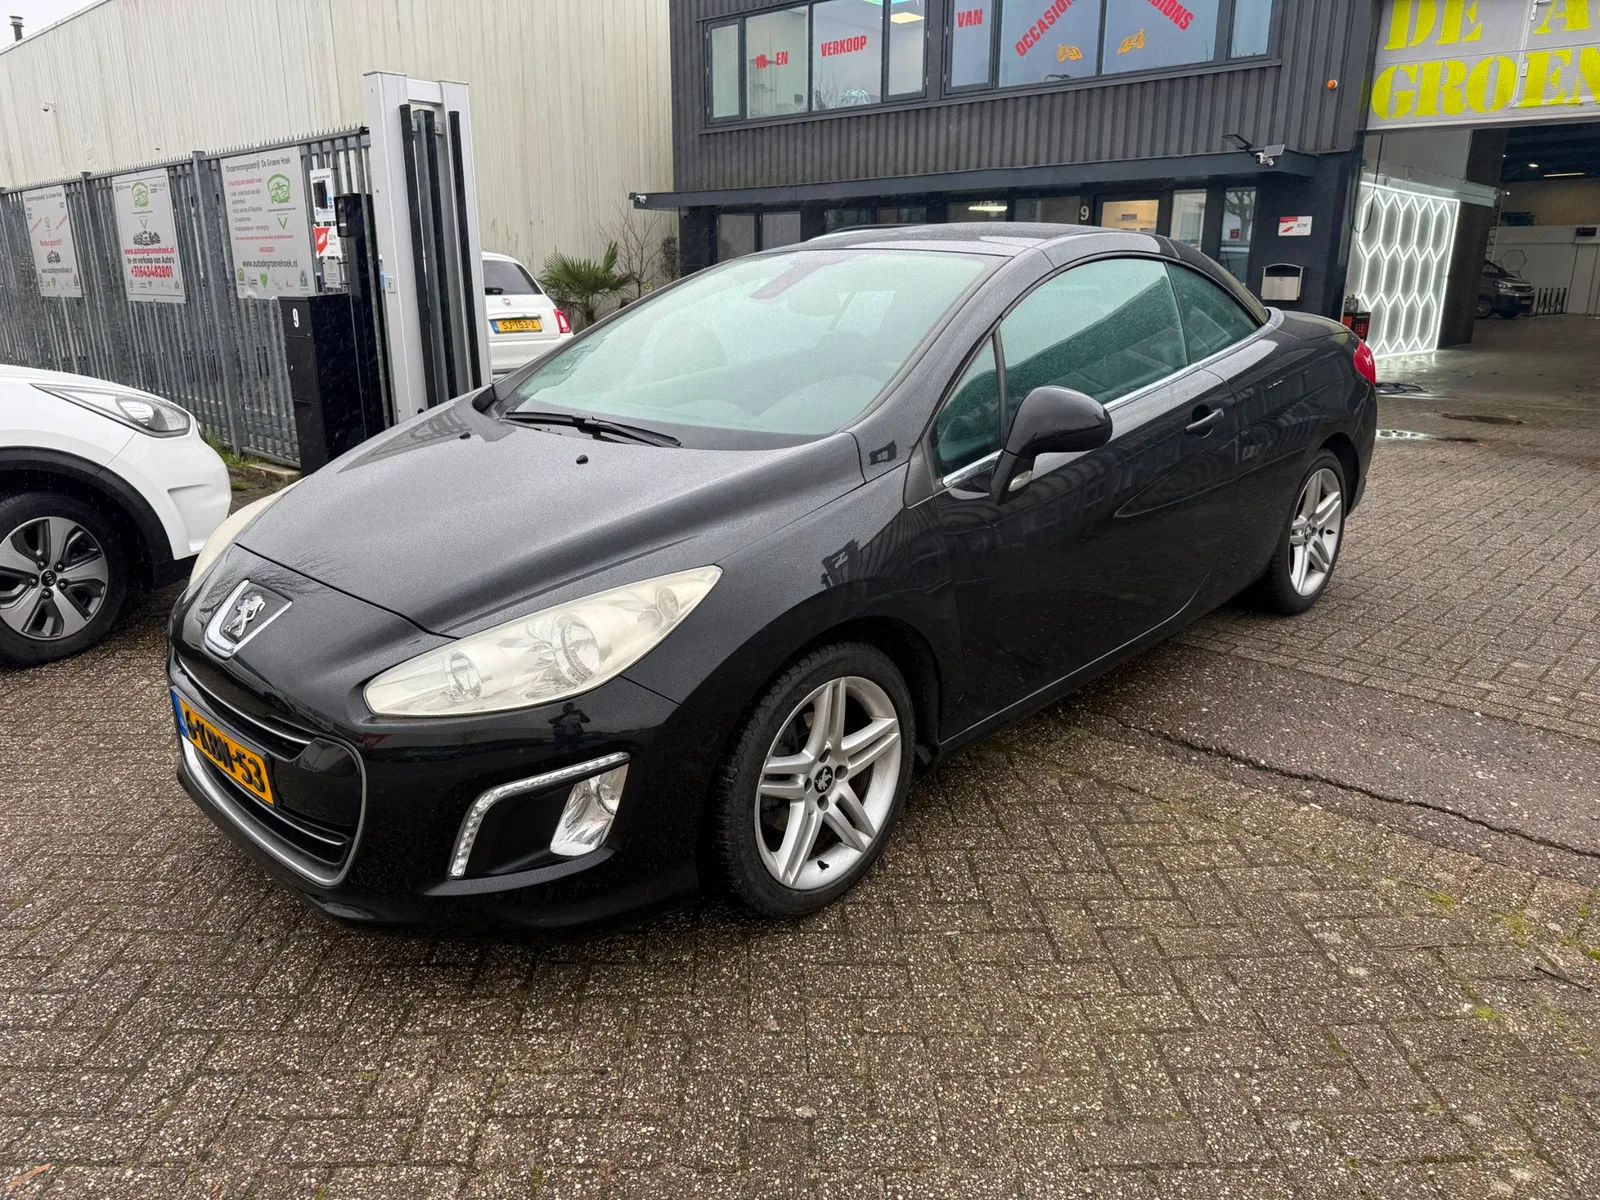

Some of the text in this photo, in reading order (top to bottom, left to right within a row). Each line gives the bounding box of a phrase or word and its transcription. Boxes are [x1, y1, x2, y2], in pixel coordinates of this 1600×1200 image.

[957, 9, 983, 28] VAN
[1383, 0, 1600, 50] DE A
[820, 34, 867, 57] VERKOOP
[775, 50, 788, 66] EN
[261, 159, 267, 168] De
[267, 158, 280, 167] Groene
[280, 156, 291, 165] Hoek
[1080, 205, 1089, 220] 9
[138, 256, 153, 266] verkoop
[242, 258, 298, 270] www.autodegroenehoek.nl
[292, 307, 300, 328] 9
[501, 320, 537, 330] SJ-153-Z
